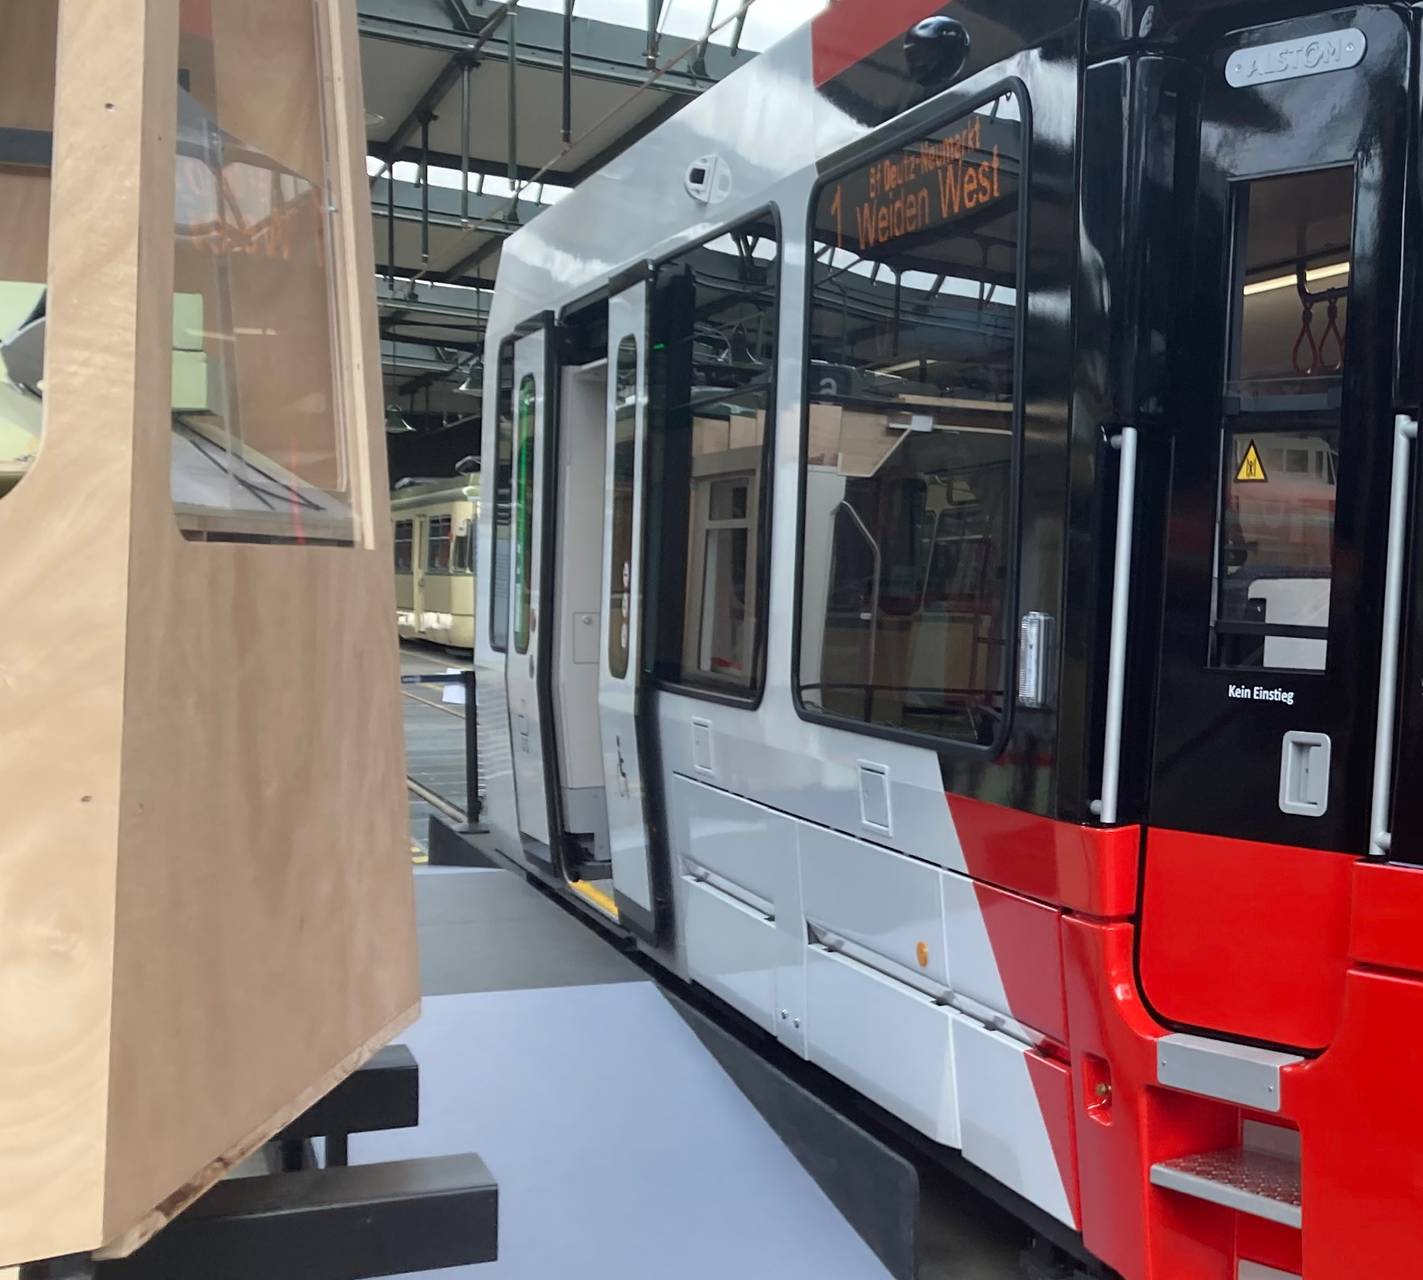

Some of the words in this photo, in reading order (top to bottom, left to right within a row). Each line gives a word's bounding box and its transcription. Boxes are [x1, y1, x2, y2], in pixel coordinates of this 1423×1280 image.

[831, 183, 843, 248] 1
[856, 187, 930, 250] Weiden
[938, 144, 1001, 218] West
[1228, 684, 1252, 699] Kein
[1253, 686, 1295, 705] Einstieg
